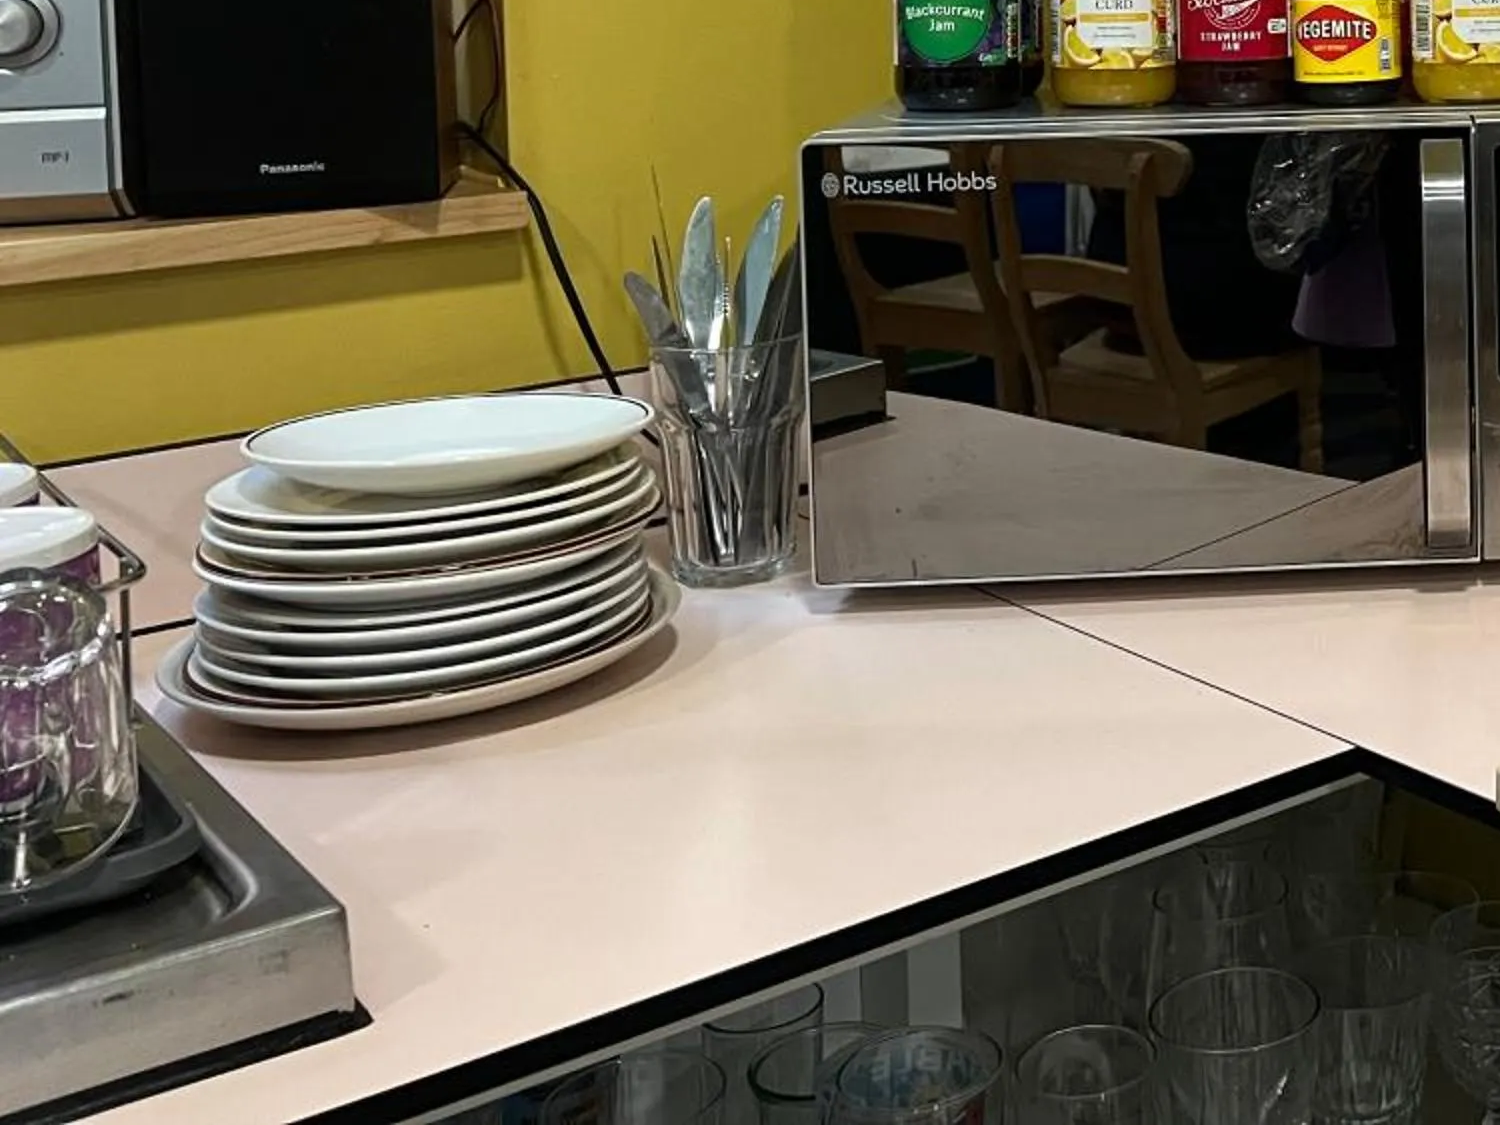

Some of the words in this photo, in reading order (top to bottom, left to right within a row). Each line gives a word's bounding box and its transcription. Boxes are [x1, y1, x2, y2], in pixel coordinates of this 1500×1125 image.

[905, 2, 985, 21] Blackcurrant
[928, 19, 955, 32] Jam
[1200, 30, 1262, 42] STRAWBERRY
[1221, 42, 1241, 52] JAM
[260, 161, 325, 175] Panasonic
[843, 173, 920, 196] Russell
[927, 171, 997, 192] Hobbs
